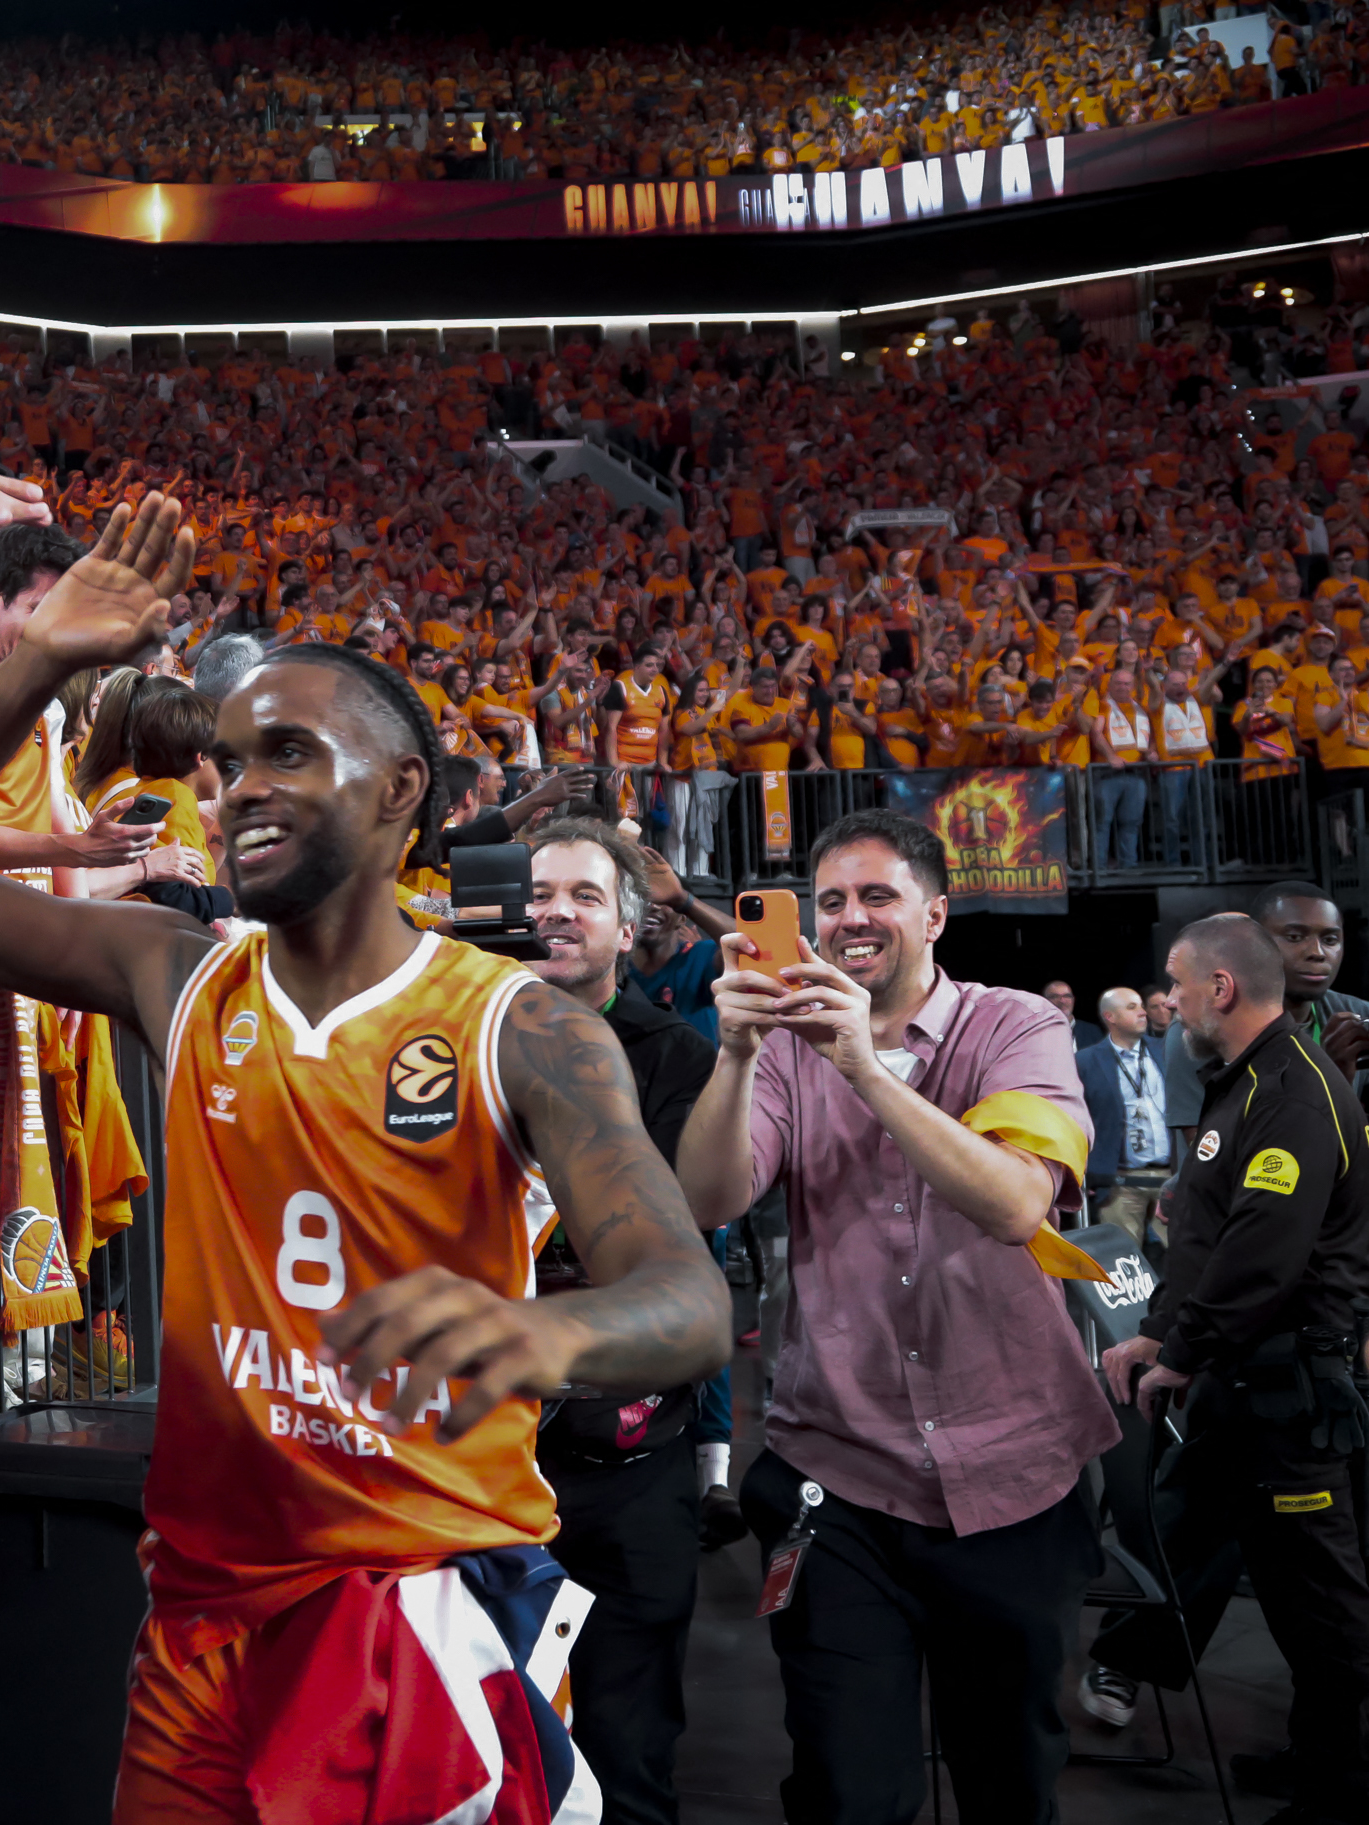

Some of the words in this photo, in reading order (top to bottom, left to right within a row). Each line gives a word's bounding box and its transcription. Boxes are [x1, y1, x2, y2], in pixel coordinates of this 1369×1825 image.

[564, 180, 718, 234] GUANYA!
[389, 1111, 455, 1125] EuroLeague
[276, 1190, 346, 1311] 8
[1278, 1495, 1328, 1508] PROSEGUR
